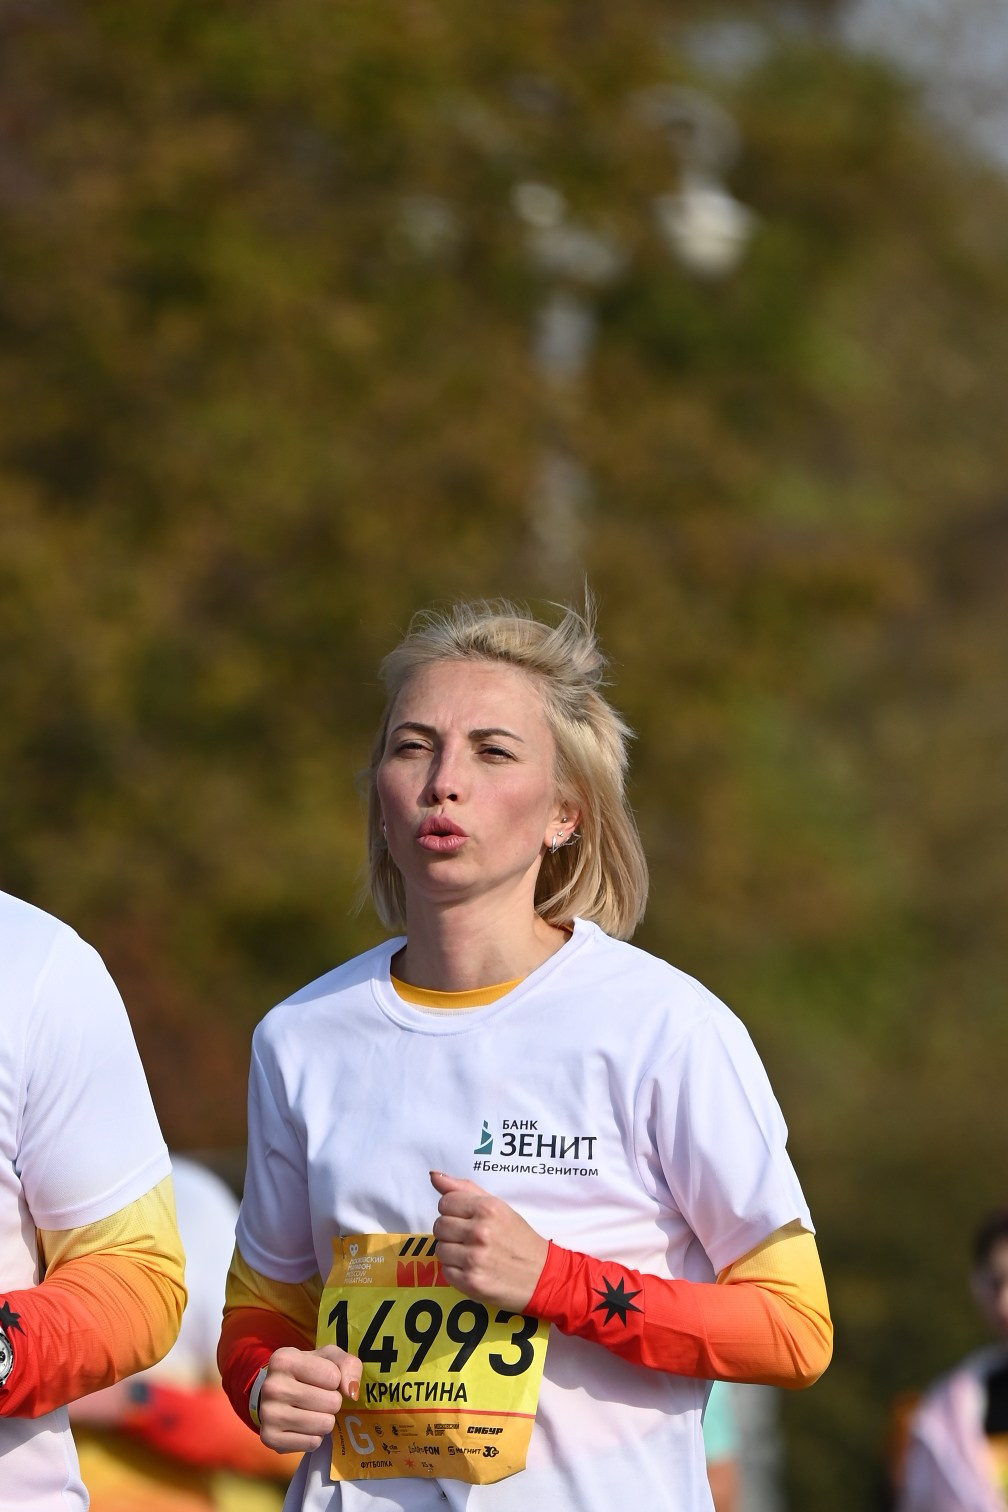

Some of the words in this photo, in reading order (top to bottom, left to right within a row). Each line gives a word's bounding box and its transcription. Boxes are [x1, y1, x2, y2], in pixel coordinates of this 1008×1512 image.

[502, 1119, 538, 1131] БАНК
[499, 1132, 598, 1160] ЗЕНИТ
[473, 1160, 599, 1177] #БежимсЗенитом
[327, 1298, 540, 1377] 14993
[365, 1381, 468, 1403] КРИСТИНА
[345, 1415, 375, 1456] G
[466, 1426, 504, 1435] СИБУР
[360, 1460, 393, 1469] ФУТБОЛКА
